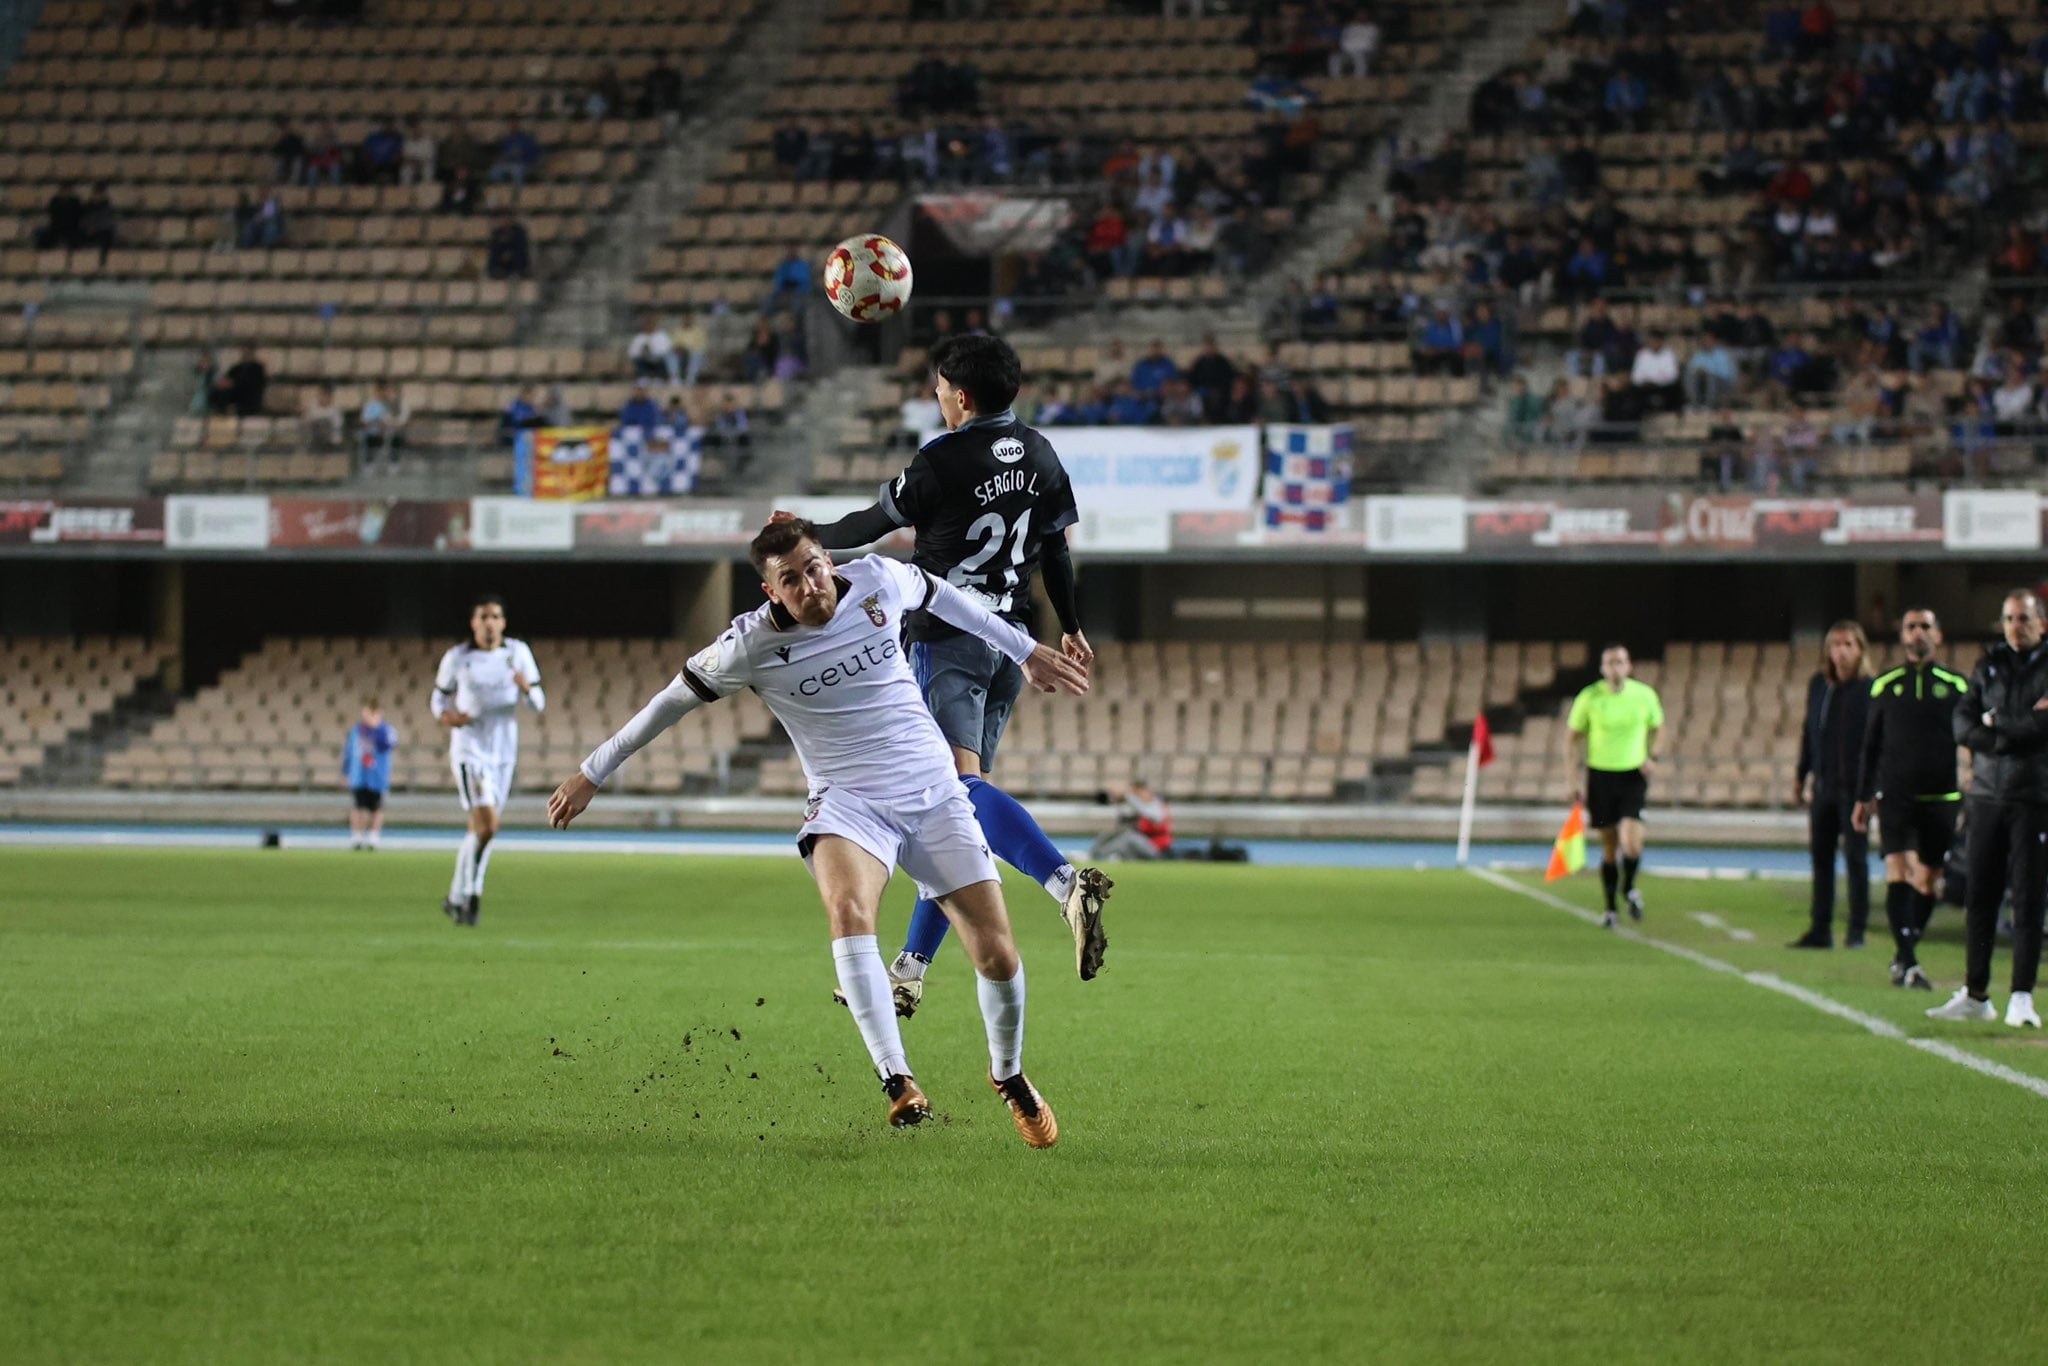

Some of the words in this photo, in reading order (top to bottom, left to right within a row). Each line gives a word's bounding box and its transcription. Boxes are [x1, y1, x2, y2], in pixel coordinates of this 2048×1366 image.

[994, 446, 1023, 457] LUGO
[974, 469, 1024, 507] SERGIO
[1027, 472, 1040, 496] L.
[946, 508, 1033, 589] 21
